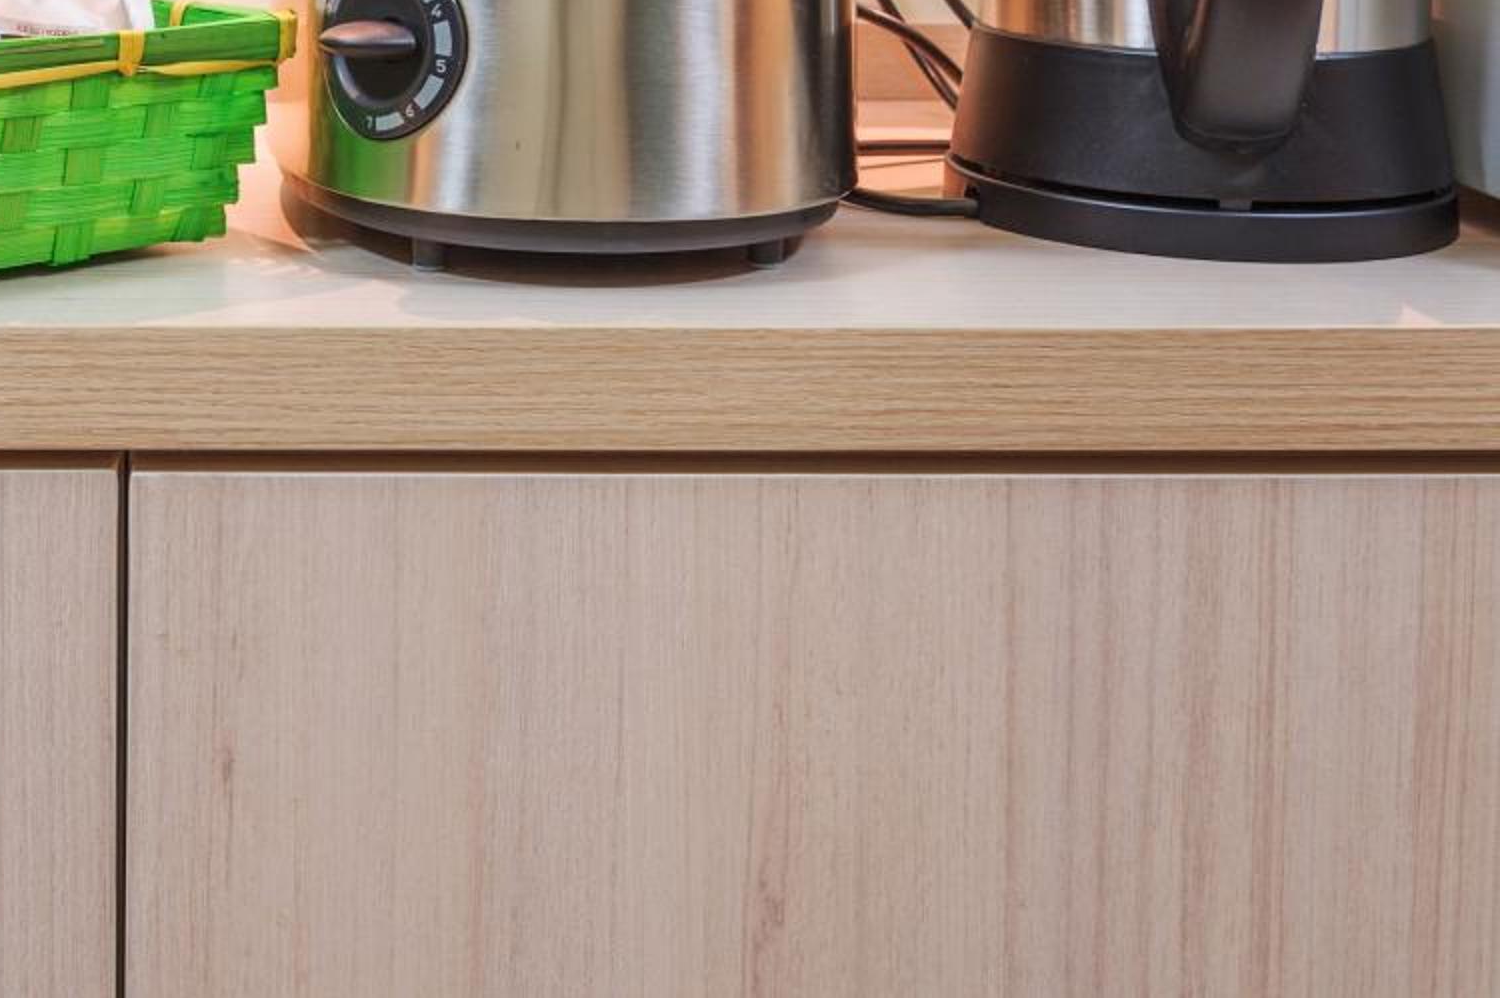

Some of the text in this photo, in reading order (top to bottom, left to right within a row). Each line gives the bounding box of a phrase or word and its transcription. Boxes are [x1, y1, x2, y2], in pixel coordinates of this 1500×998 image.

[431, 3, 443, 18] 4
[435, 59, 446, 73] 5
[405, 105, 415, 117] 6
